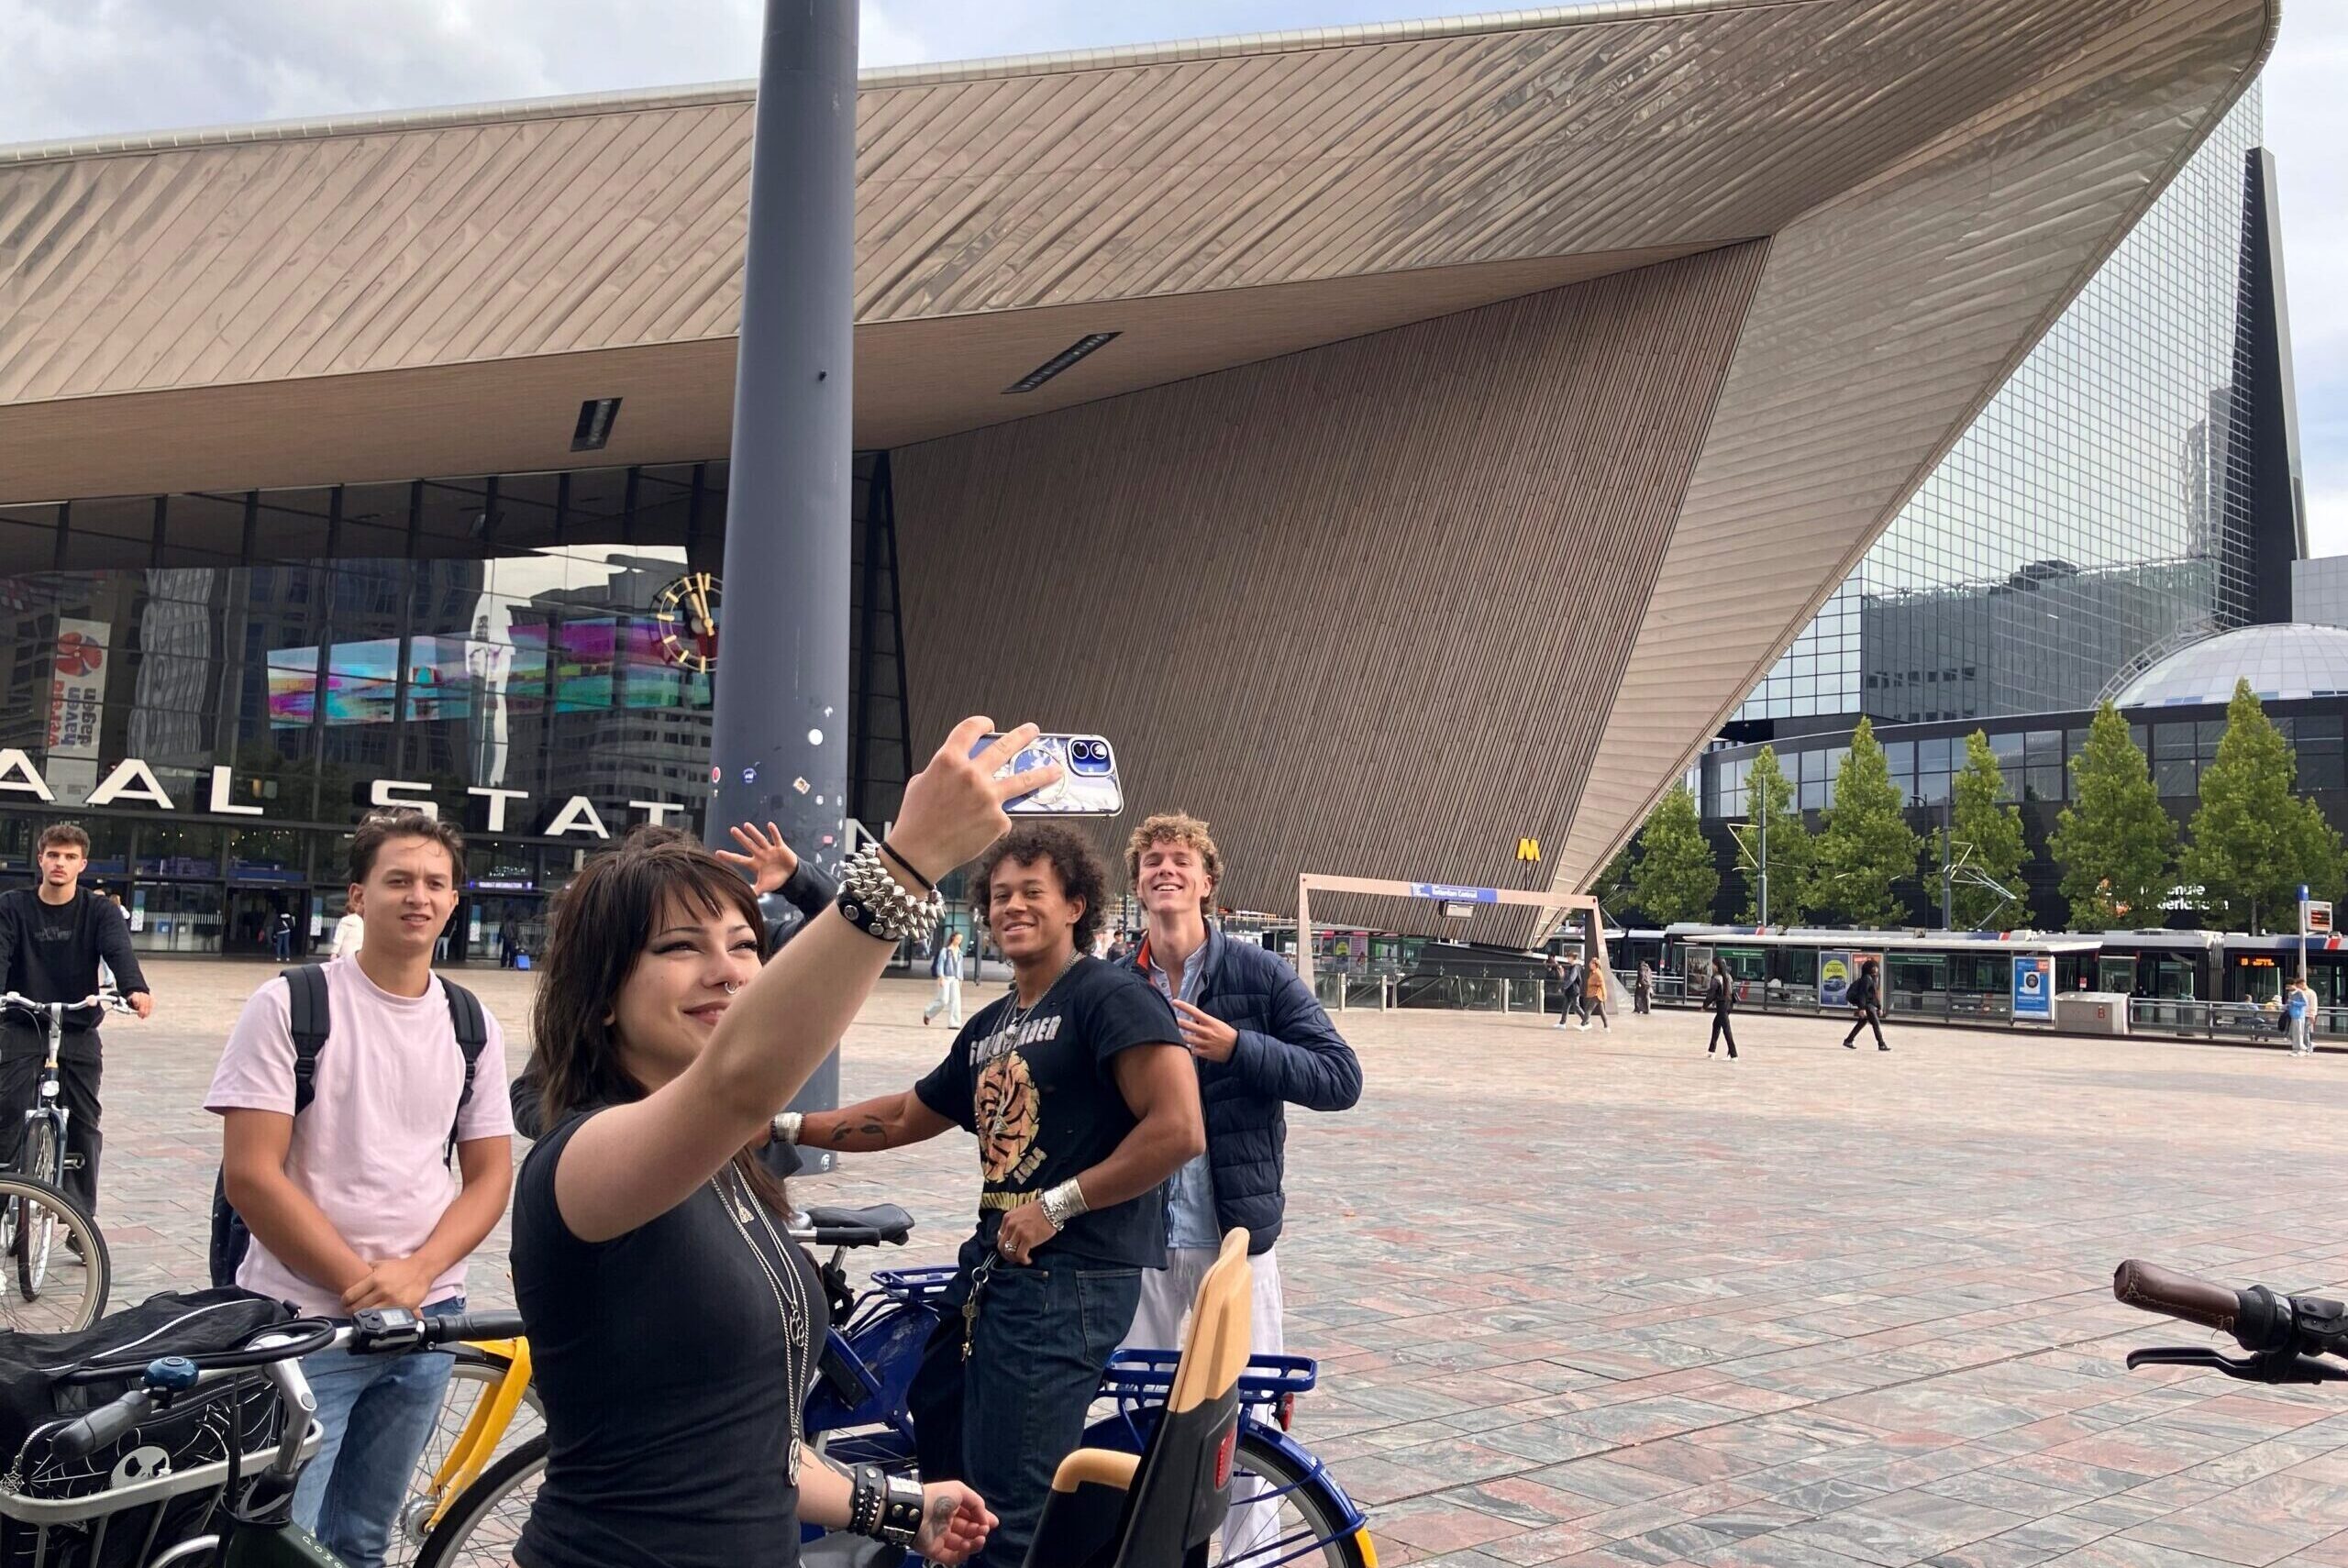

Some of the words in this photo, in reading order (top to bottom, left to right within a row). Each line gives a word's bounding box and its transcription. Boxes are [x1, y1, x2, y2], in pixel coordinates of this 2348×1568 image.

[61, 687, 81, 745] haven
[77, 689, 96, 748] dagen
[1516, 837, 1540, 862] M
